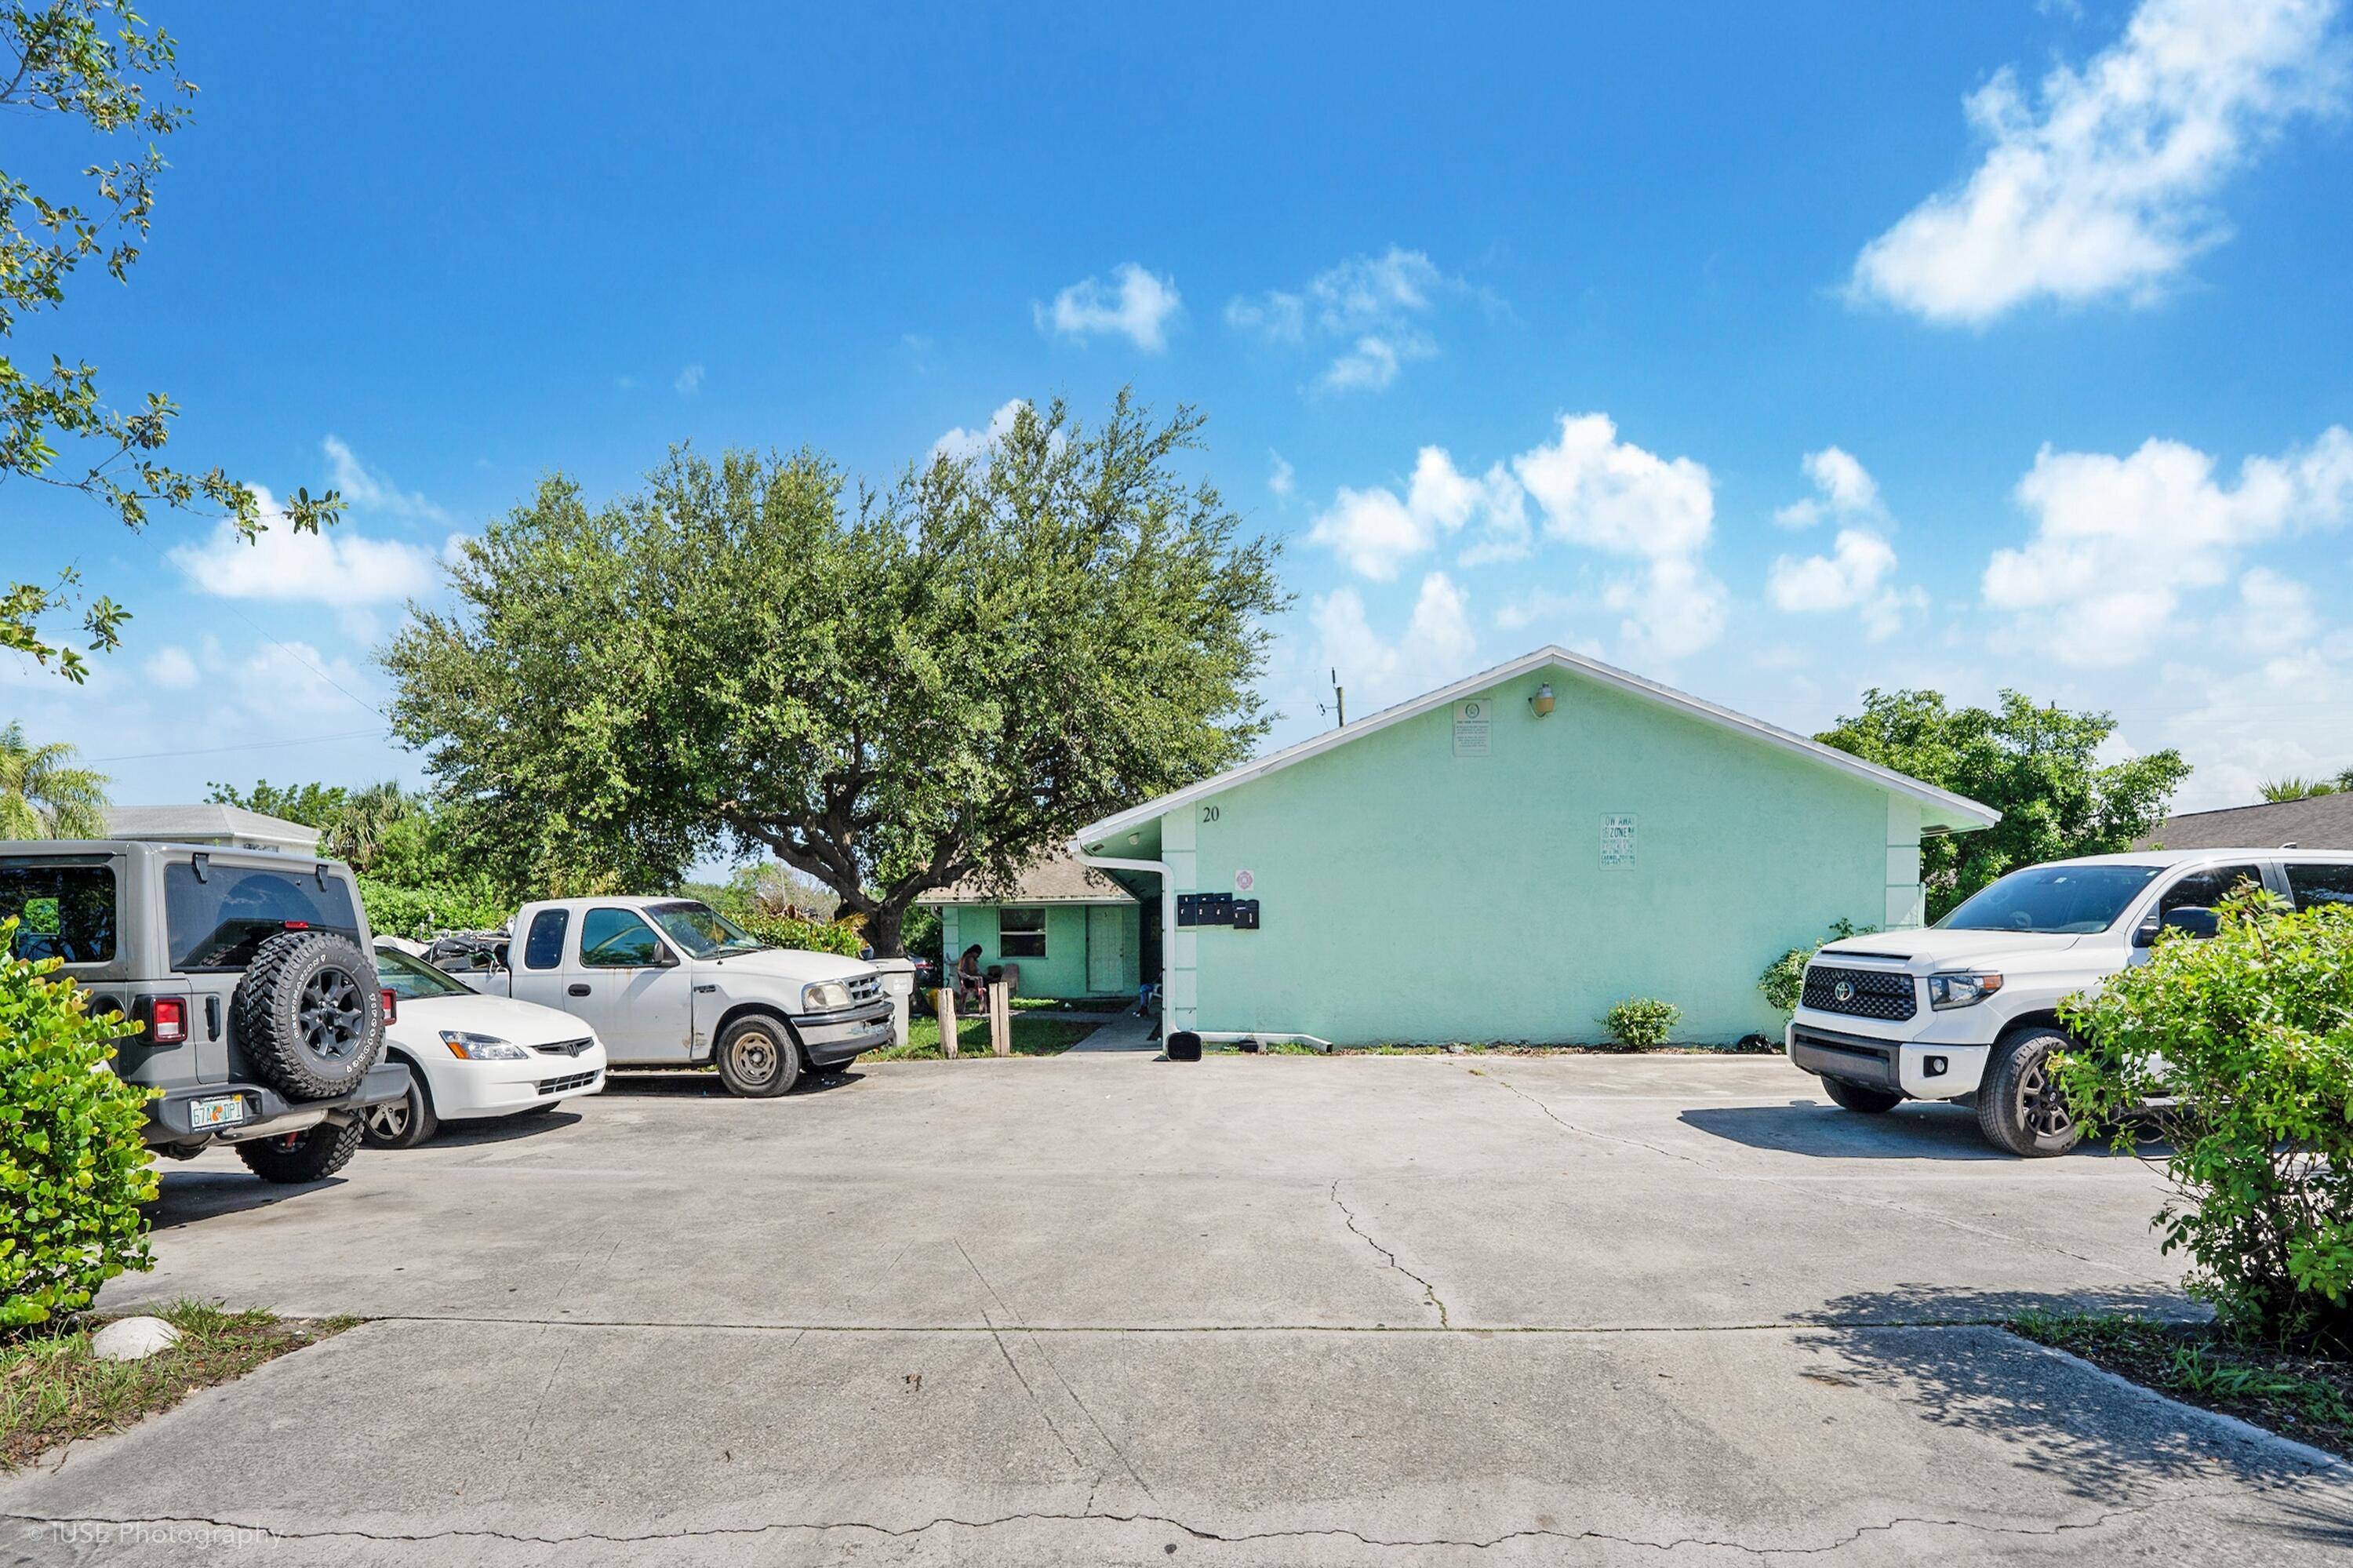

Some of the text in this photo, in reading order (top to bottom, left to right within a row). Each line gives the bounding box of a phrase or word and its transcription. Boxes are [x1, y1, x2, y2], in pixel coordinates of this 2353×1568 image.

[1203, 806, 1219, 822] 20
[1609, 827, 1627, 838] ZONE
[290, 958, 321, 1039] DESTINATION
